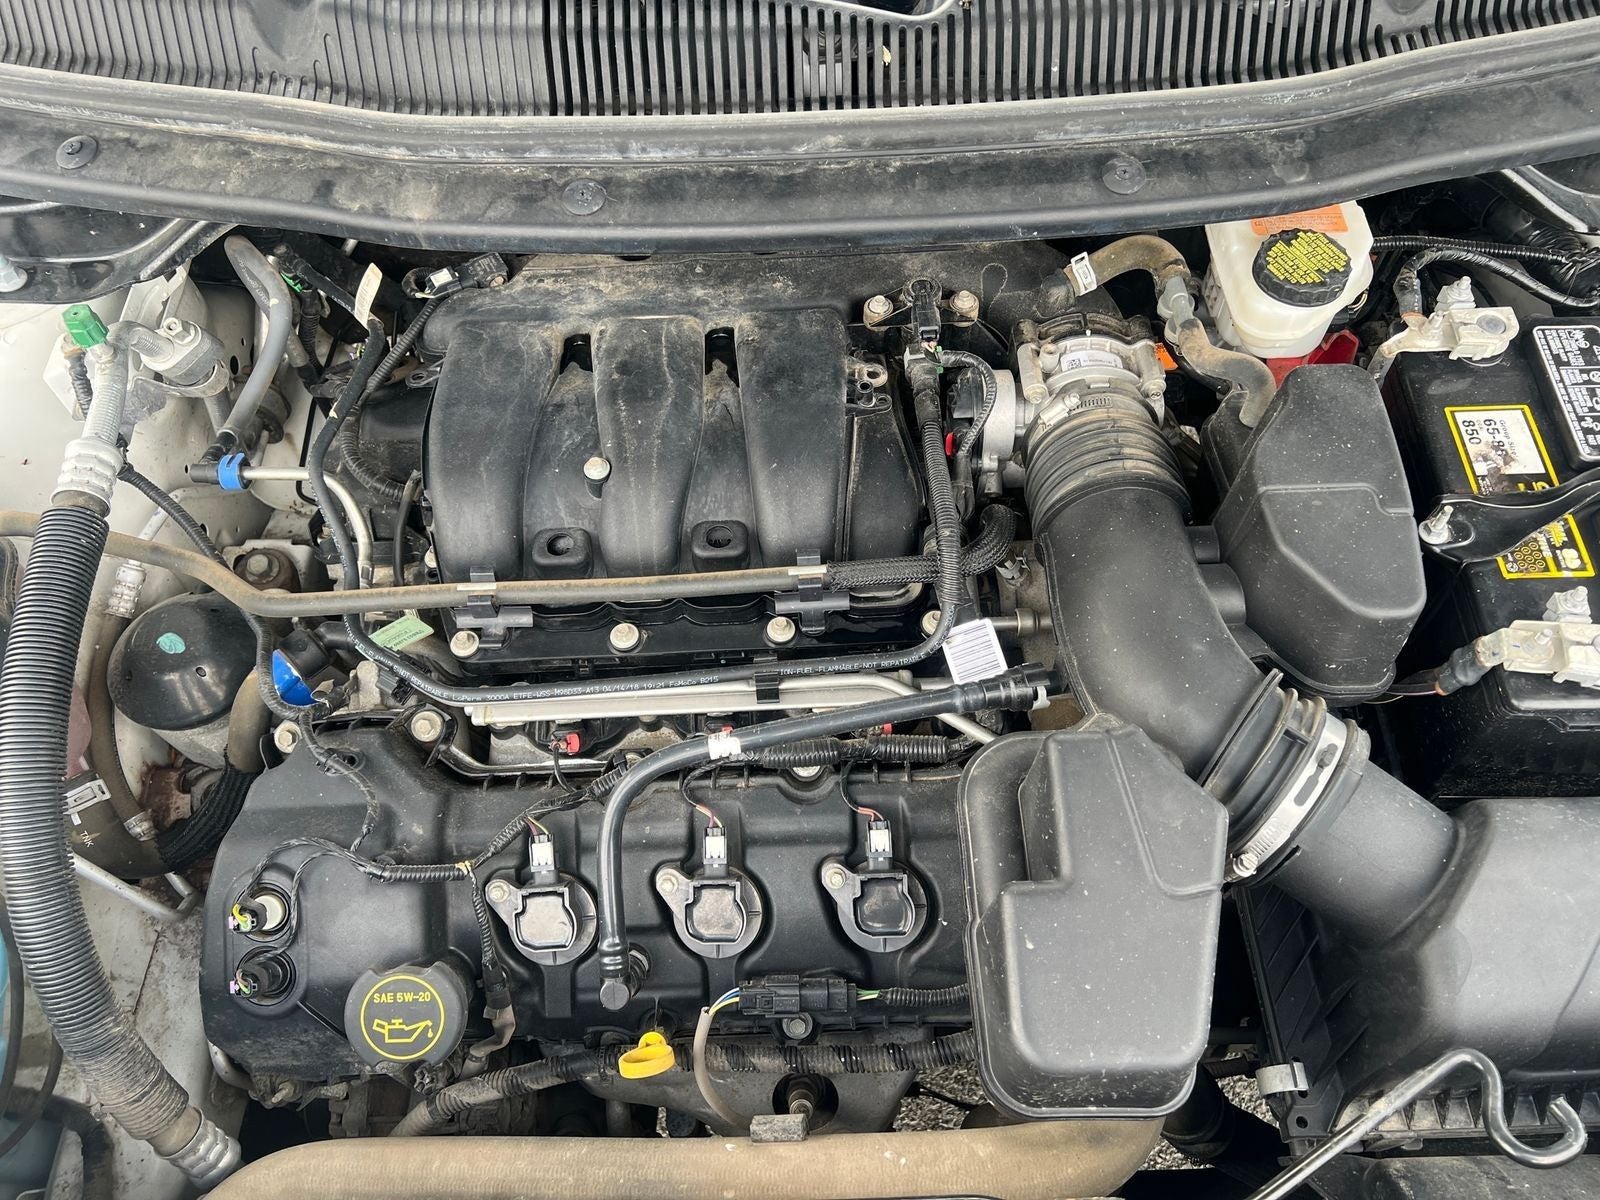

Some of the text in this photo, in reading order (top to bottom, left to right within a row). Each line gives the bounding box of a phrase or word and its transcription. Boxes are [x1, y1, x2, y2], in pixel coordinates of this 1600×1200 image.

[1462, 420, 1482, 446] 850
[1499, 420, 1511, 440] Group
[373, 991, 431, 1004] SAE 5W-20
